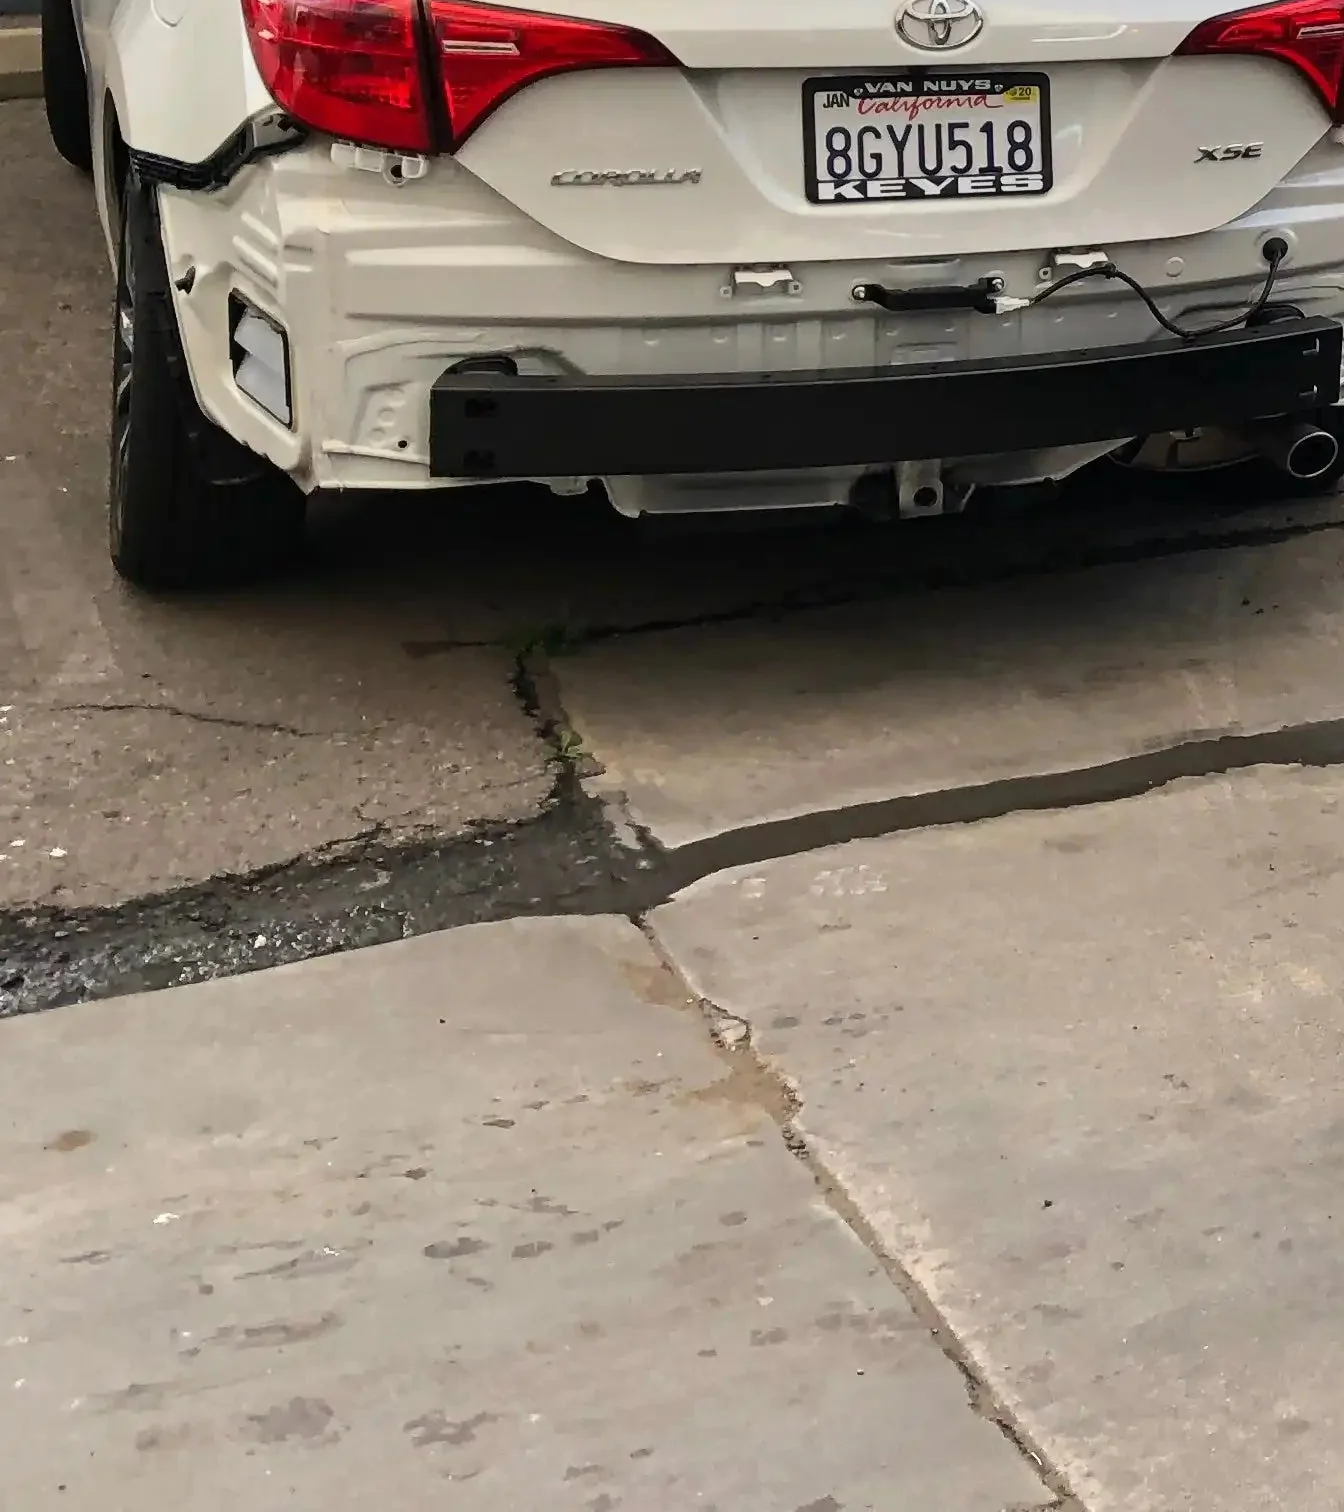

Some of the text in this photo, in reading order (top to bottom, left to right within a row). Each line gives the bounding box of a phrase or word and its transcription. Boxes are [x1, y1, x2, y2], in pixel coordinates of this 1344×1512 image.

[864, 79, 991, 93] VAN NUYS
[1018, 87, 1032, 97] 20
[823, 92, 1003, 121] JAN California
[825, 120, 1034, 179] 8GYU518
[1193, 141, 1264, 164] XSE
[550, 167, 702, 188] COROLLA
[817, 174, 1044, 200] KEYES
